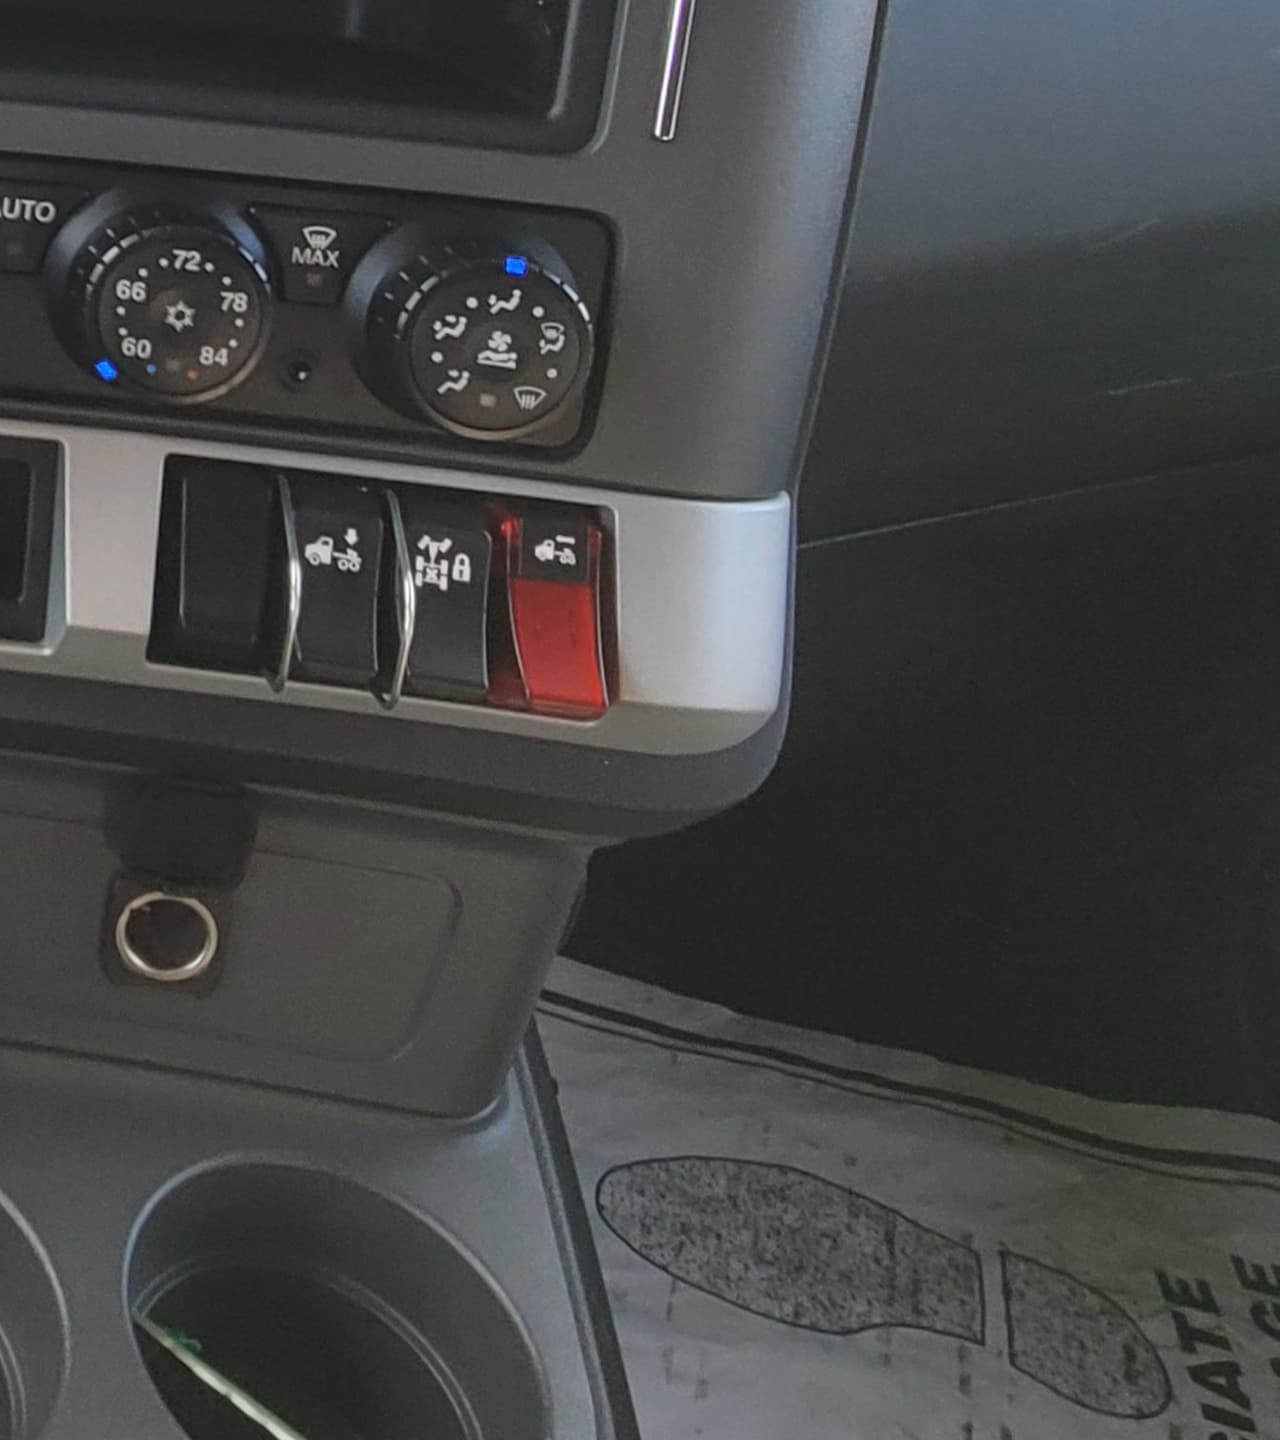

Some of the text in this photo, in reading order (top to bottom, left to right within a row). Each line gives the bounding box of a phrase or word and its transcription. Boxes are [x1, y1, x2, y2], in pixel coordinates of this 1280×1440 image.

[172, 248, 201, 271] 72
[291, 246, 340, 268] MAX
[115, 278, 147, 302] 66
[220, 291, 248, 312] 78
[121, 336, 152, 359] 60
[199, 345, 229, 366] 84
